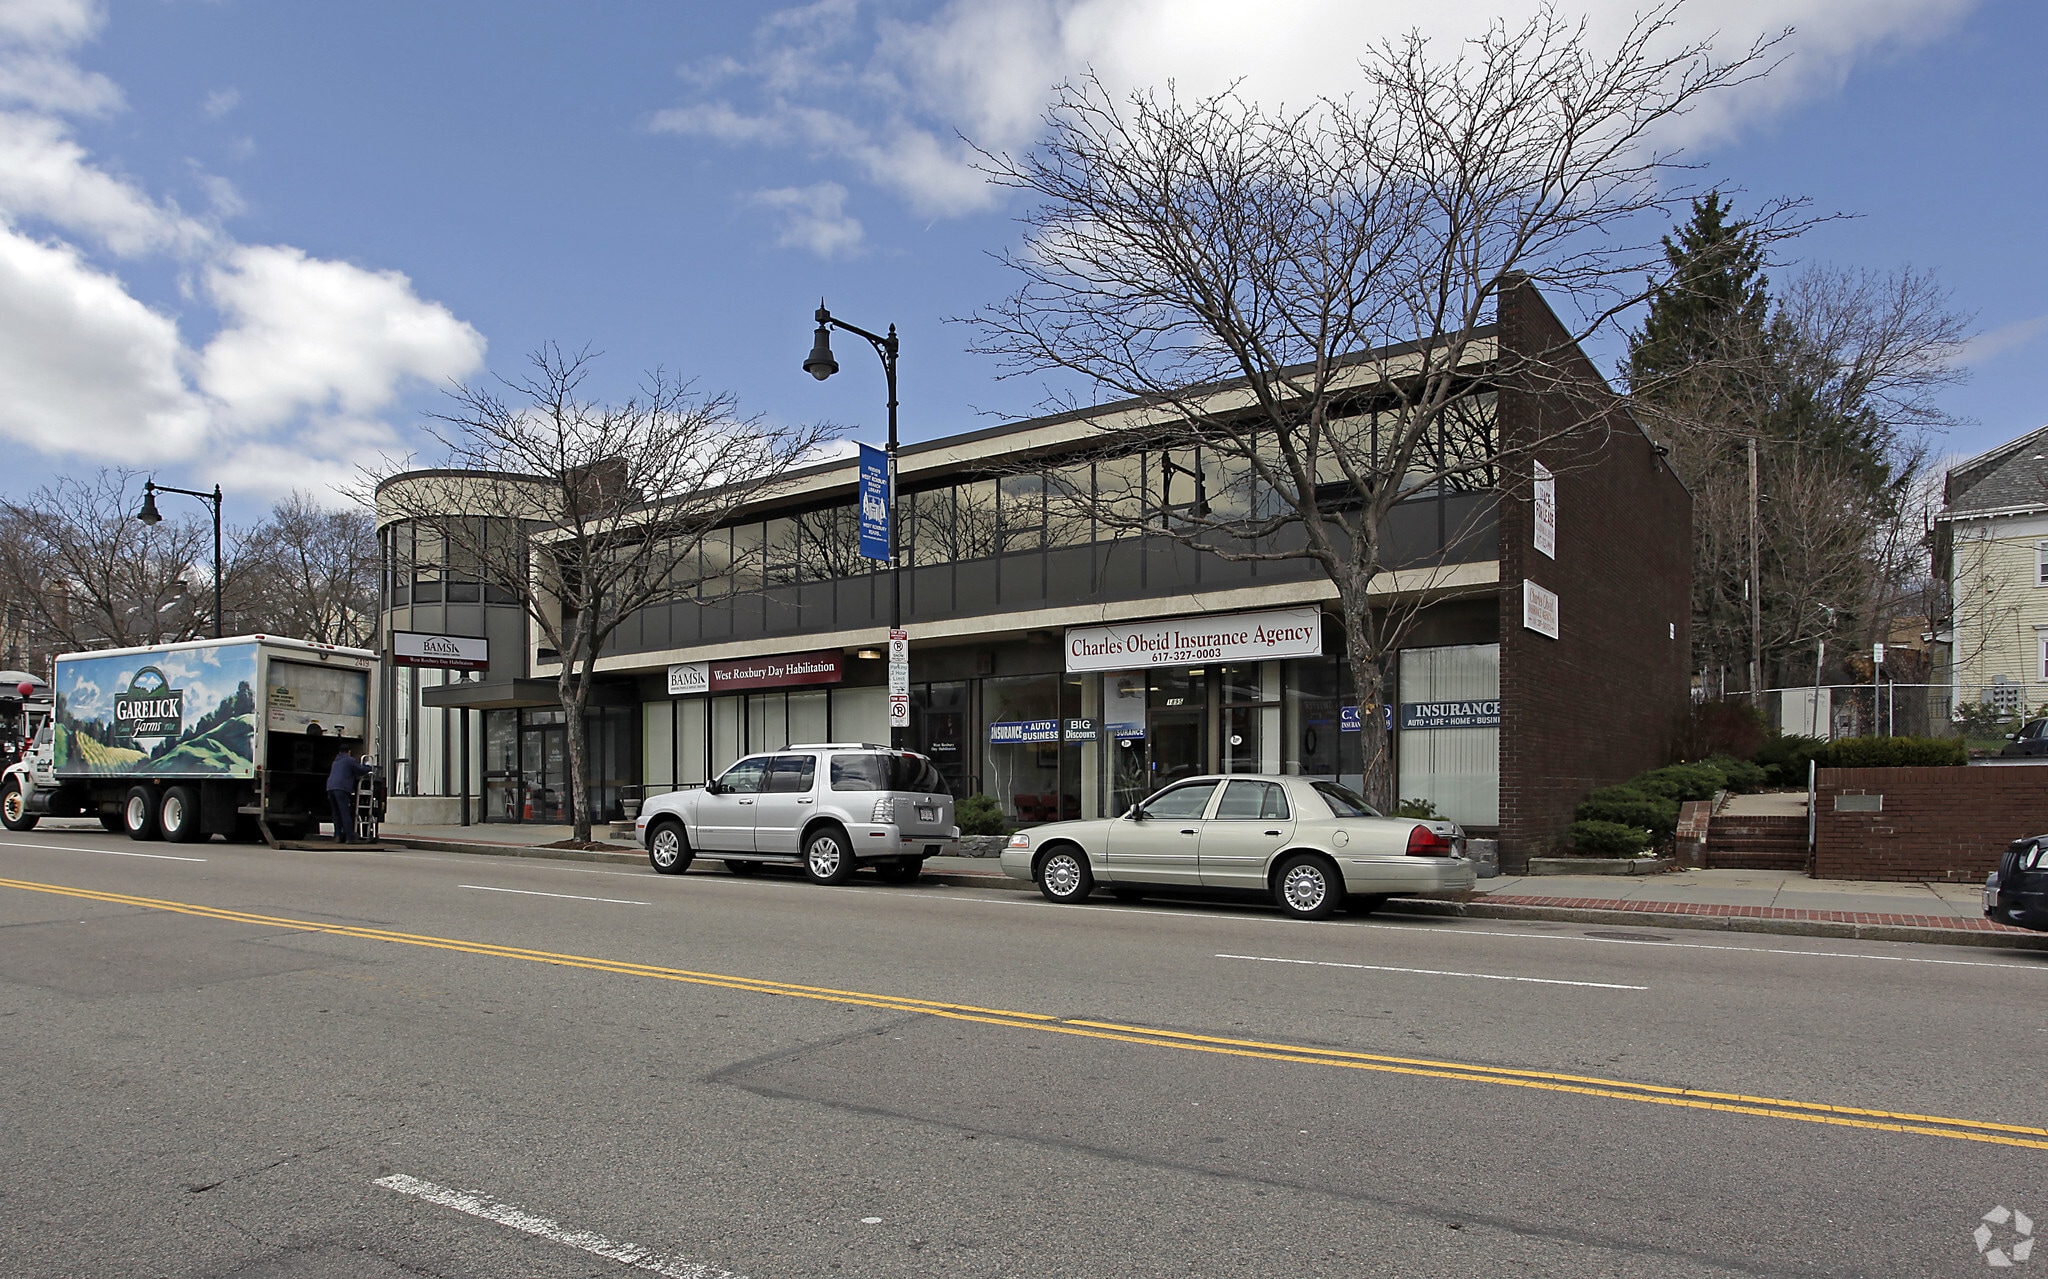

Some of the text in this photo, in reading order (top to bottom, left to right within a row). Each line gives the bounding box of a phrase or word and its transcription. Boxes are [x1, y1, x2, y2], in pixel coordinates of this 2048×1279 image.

[872, 476, 887, 485] ROXBURY
[1543, 509, 1554, 528] LEASE
[863, 522, 872, 530] WEST
[1072, 624, 1313, 657] Charles Obeid Insurance Agency
[1152, 648, 1222, 662] 617-327-0003
[714, 661, 834, 681] West Roxbury Day Habilitation
[671, 673, 704, 686] BAMSI
[117, 698, 179, 720] GARELICK
[131, 719, 162, 737] Farms
[1030, 722, 1050, 731] AUTO
[1070, 720, 1091, 729] BIG
[1430, 718, 1444, 726] LIFE
[1450, 717, 1470, 725] HOME
[991, 726, 1022, 739] INSURANCE
[1022, 731, 1058, 740] BUSINESS
